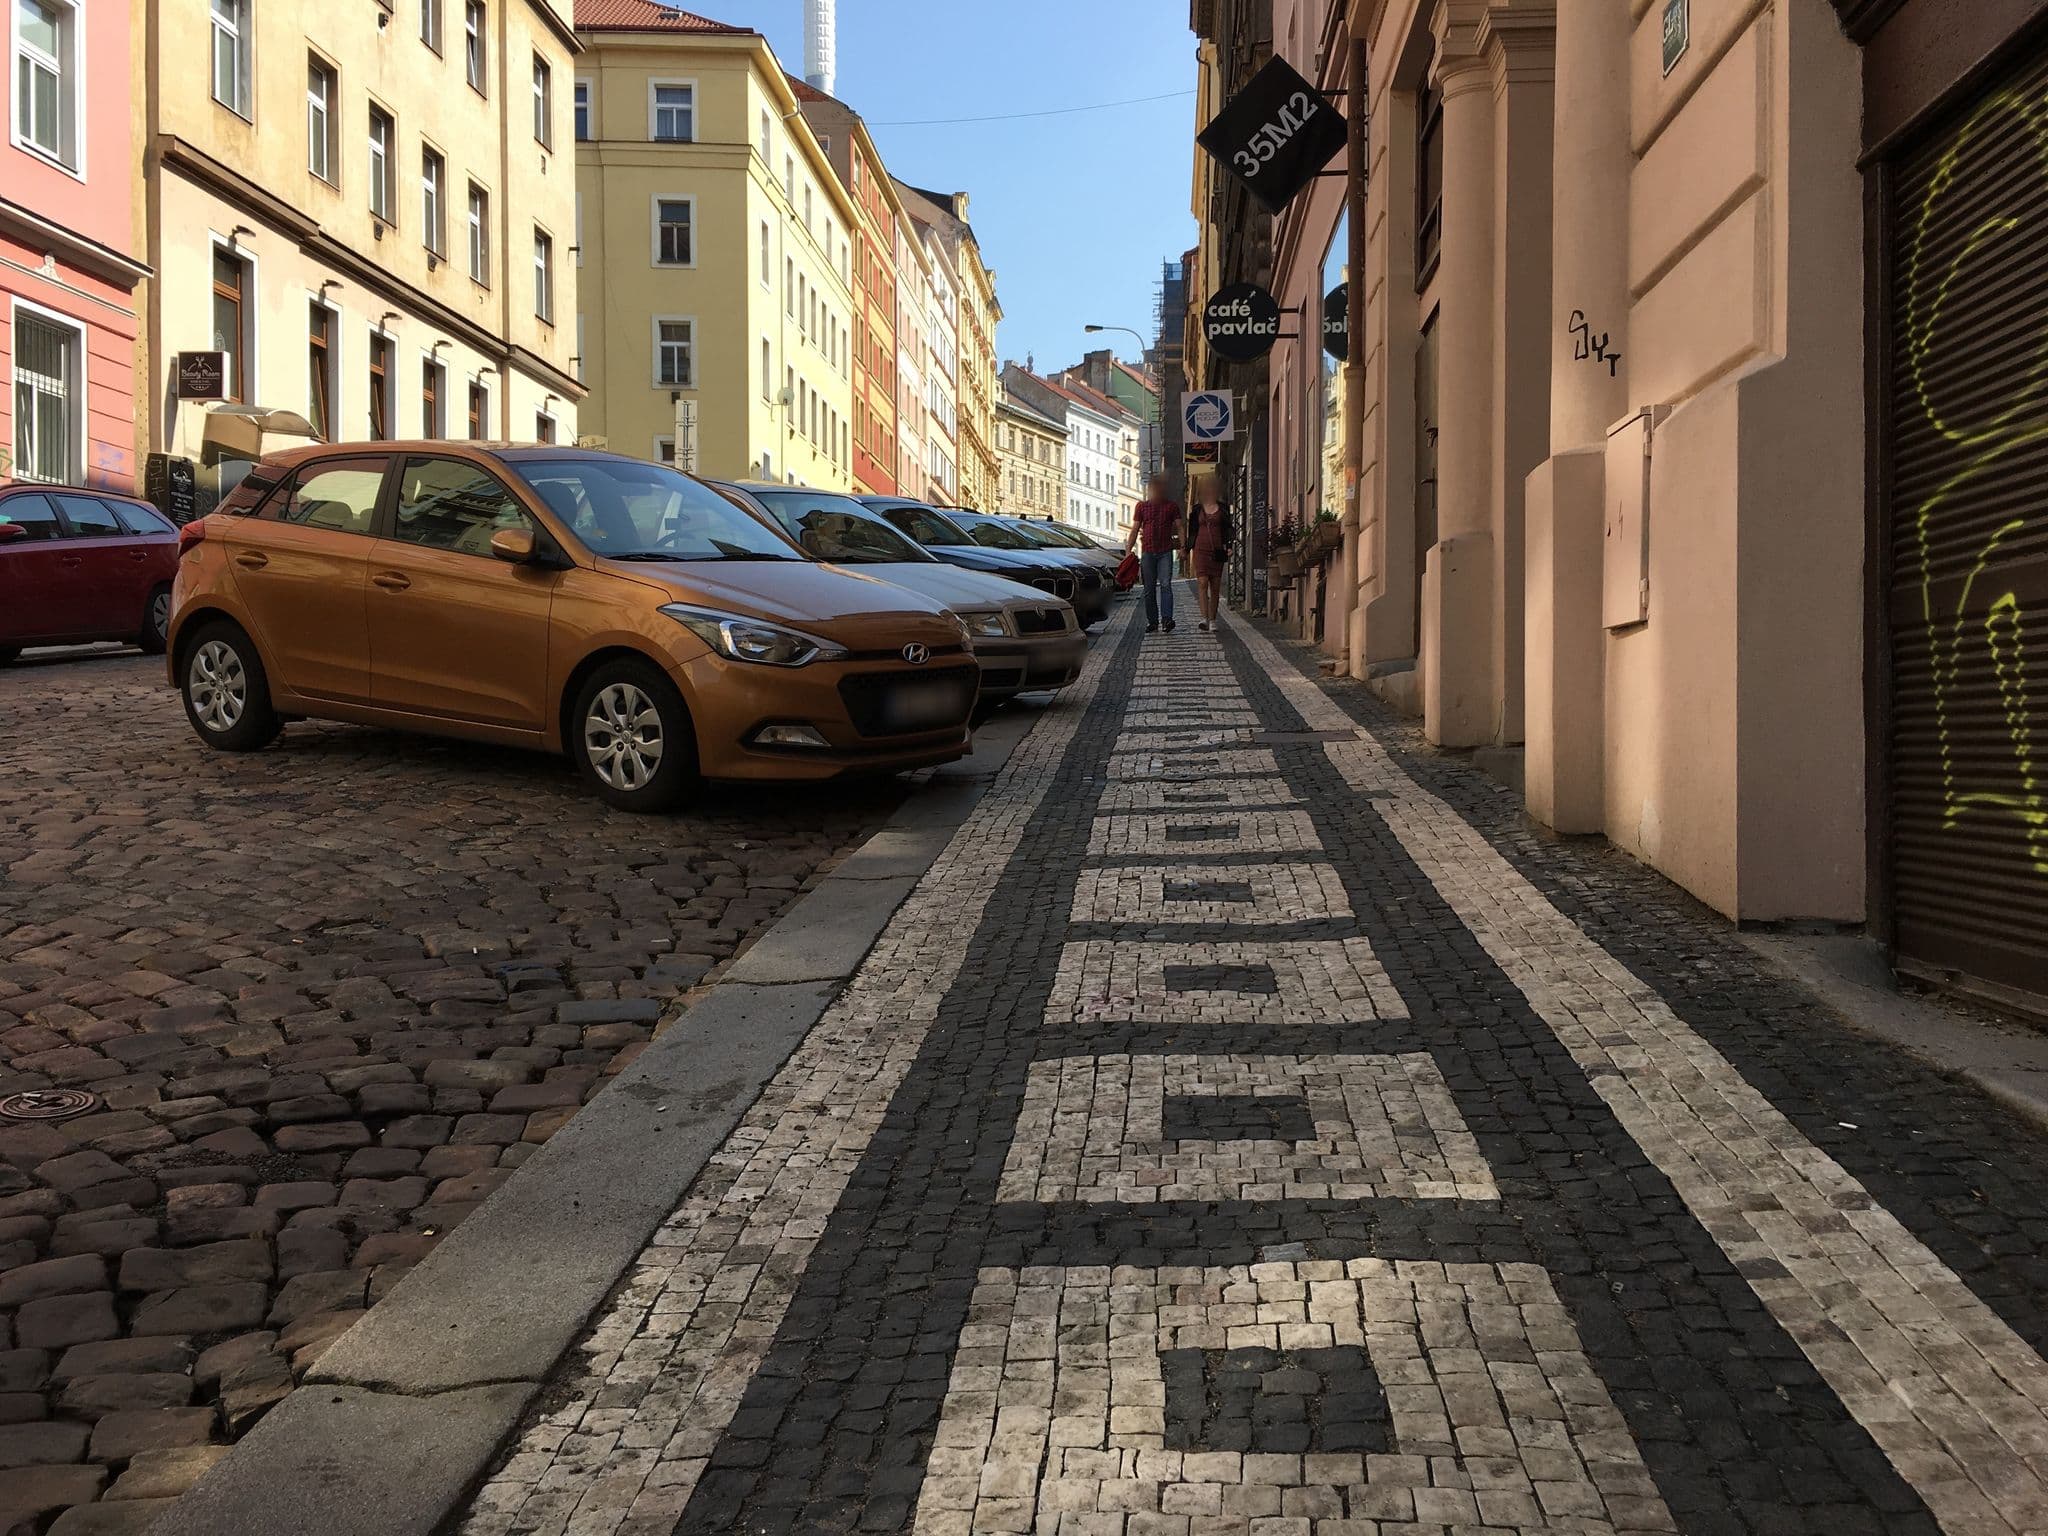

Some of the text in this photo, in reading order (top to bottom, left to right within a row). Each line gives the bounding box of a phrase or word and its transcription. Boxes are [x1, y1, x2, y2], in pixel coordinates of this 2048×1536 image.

[1234, 92, 1318, 177] 35M2
[1208, 299, 1250, 317] café
[1208, 317, 1277, 340] pavlač
[181, 369, 220, 380] Beauty Room
